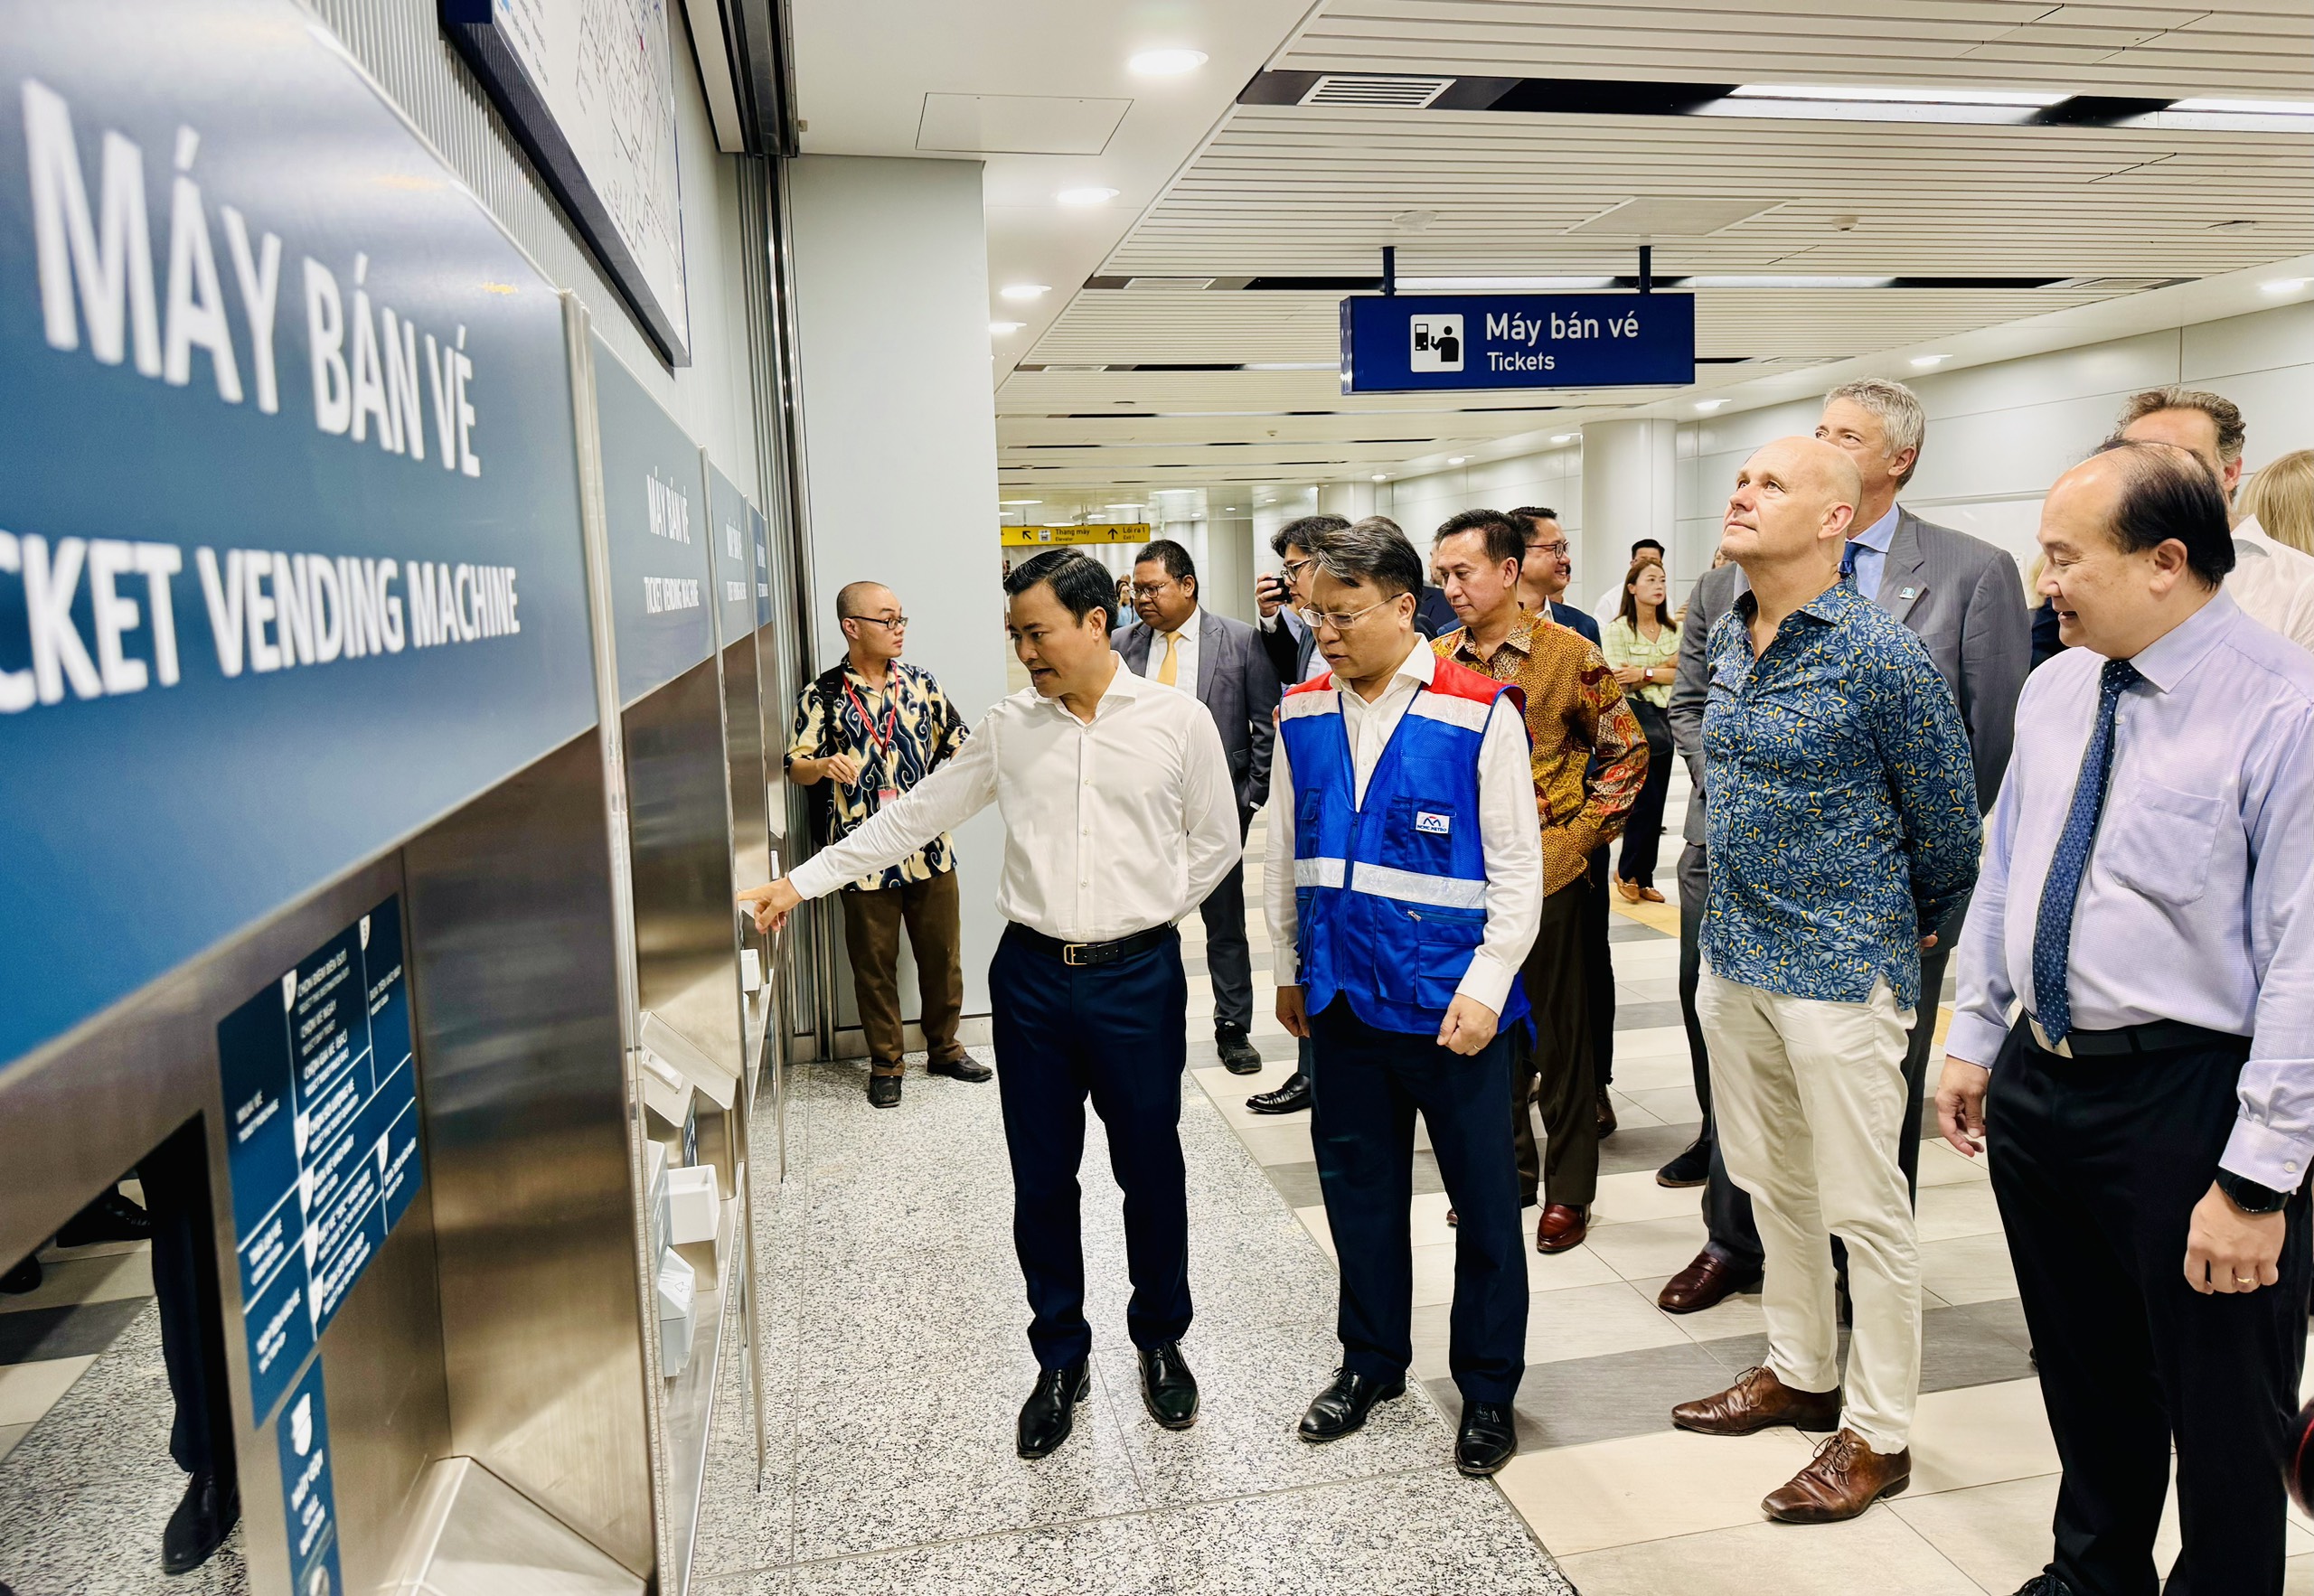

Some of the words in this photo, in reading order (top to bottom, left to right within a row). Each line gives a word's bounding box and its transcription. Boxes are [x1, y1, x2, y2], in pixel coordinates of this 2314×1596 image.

[21, 77, 282, 415] MÁY
[302, 252, 424, 462] BÁN
[425, 324, 482, 479] VÉ
[1485, 311, 1542, 347] Máy
[1550, 311, 1600, 340] bán
[1609, 310, 1640, 338] vé
[1486, 351, 1556, 371] Tickets
[1055, 528, 1075, 536] Thang
[196, 546, 404, 678] VENDING
[407, 561, 521, 649] MACHINE
